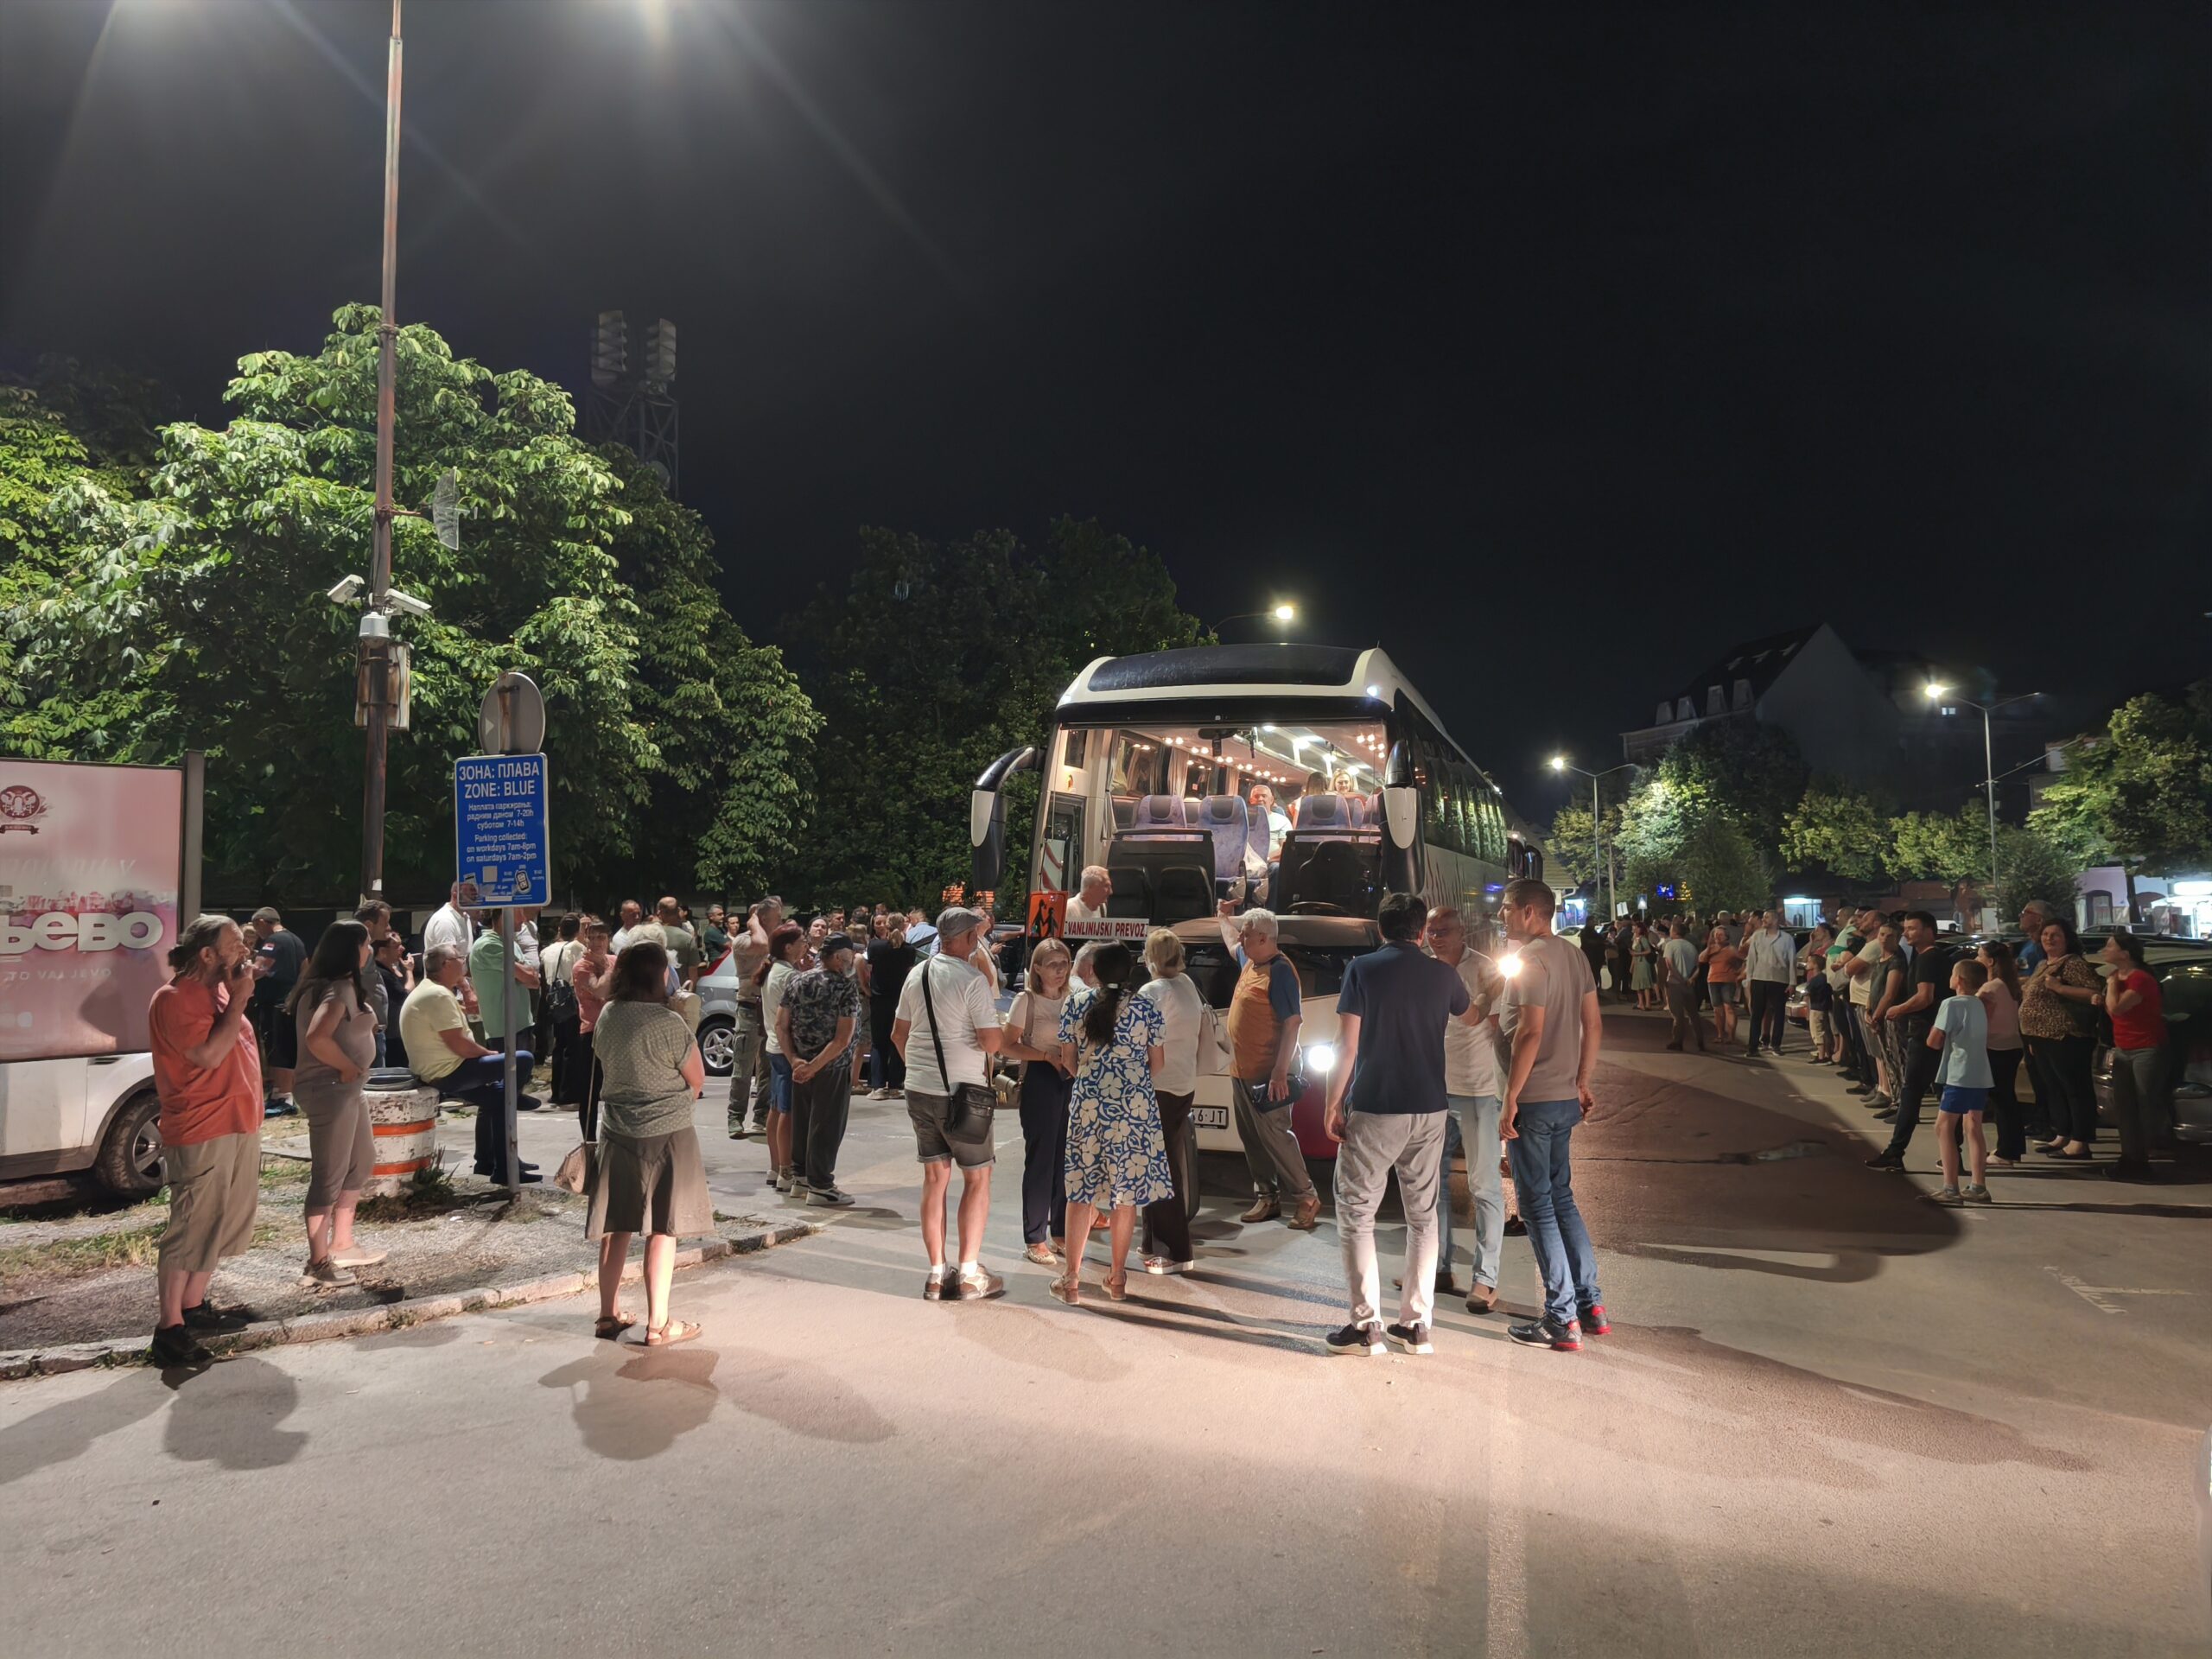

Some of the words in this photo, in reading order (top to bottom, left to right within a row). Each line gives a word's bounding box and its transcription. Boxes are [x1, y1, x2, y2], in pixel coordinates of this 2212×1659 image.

[459, 765, 495, 781] ЗОНА:
[498, 761, 540, 778] ПЛАВА
[464, 782, 501, 798] ZONE:
[504, 779, 536, 797] BLUE
[507, 819, 524, 829] 7-14h
[474, 834, 498, 843] Parking
[476, 843, 506, 854] workdays
[476, 854, 506, 863] saturdays
[508, 852, 537, 861] 7am-2pm
[1068, 920, 1113, 937] VANLINIJSKI
[1115, 923, 1145, 938] PREVOZ
